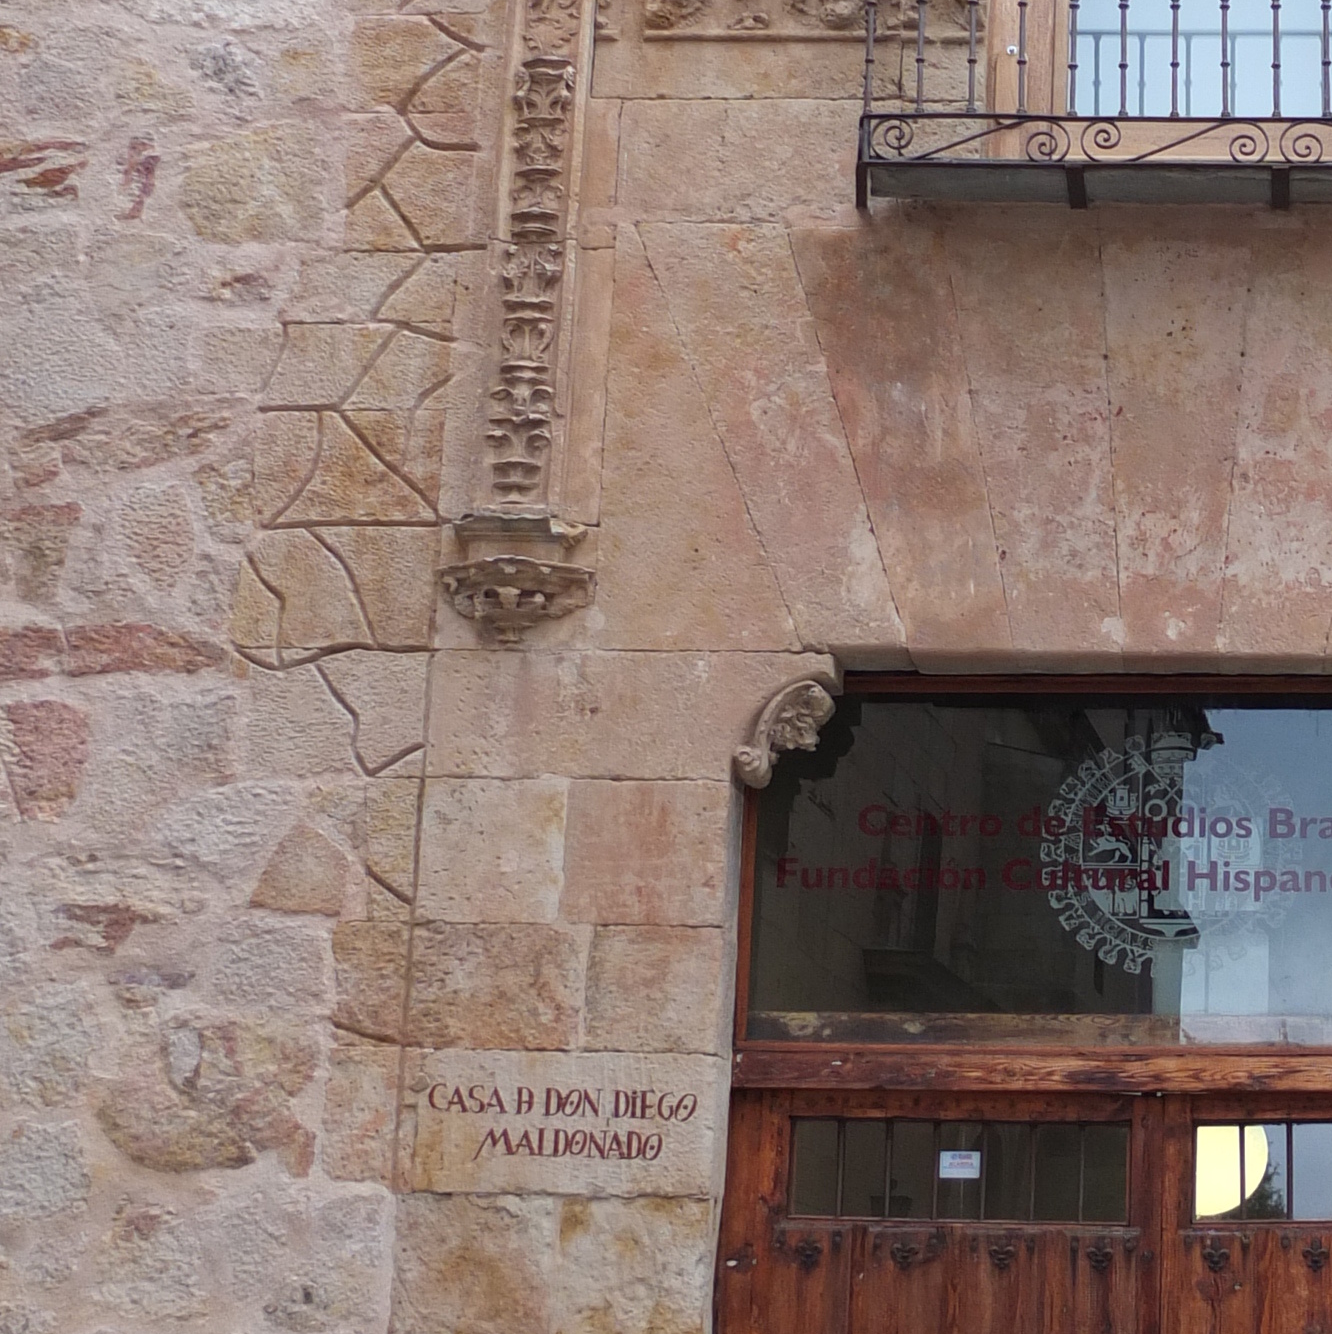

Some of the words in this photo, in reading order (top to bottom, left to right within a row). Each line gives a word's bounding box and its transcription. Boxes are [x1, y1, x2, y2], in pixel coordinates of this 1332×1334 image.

[858, 803, 1001, 837] Centro
[1017, 802, 1067, 837] de
[1083, 805, 1252, 839] Estudios
[776, 856, 986, 890] Fundación
[1002, 858, 1169, 892] Cultural
[427, 1082, 507, 1114] CASA
[543, 1086, 604, 1117] DON
[612, 1088, 698, 1122] DIEGO
[472, 1127, 663, 1161] MALDONADO
